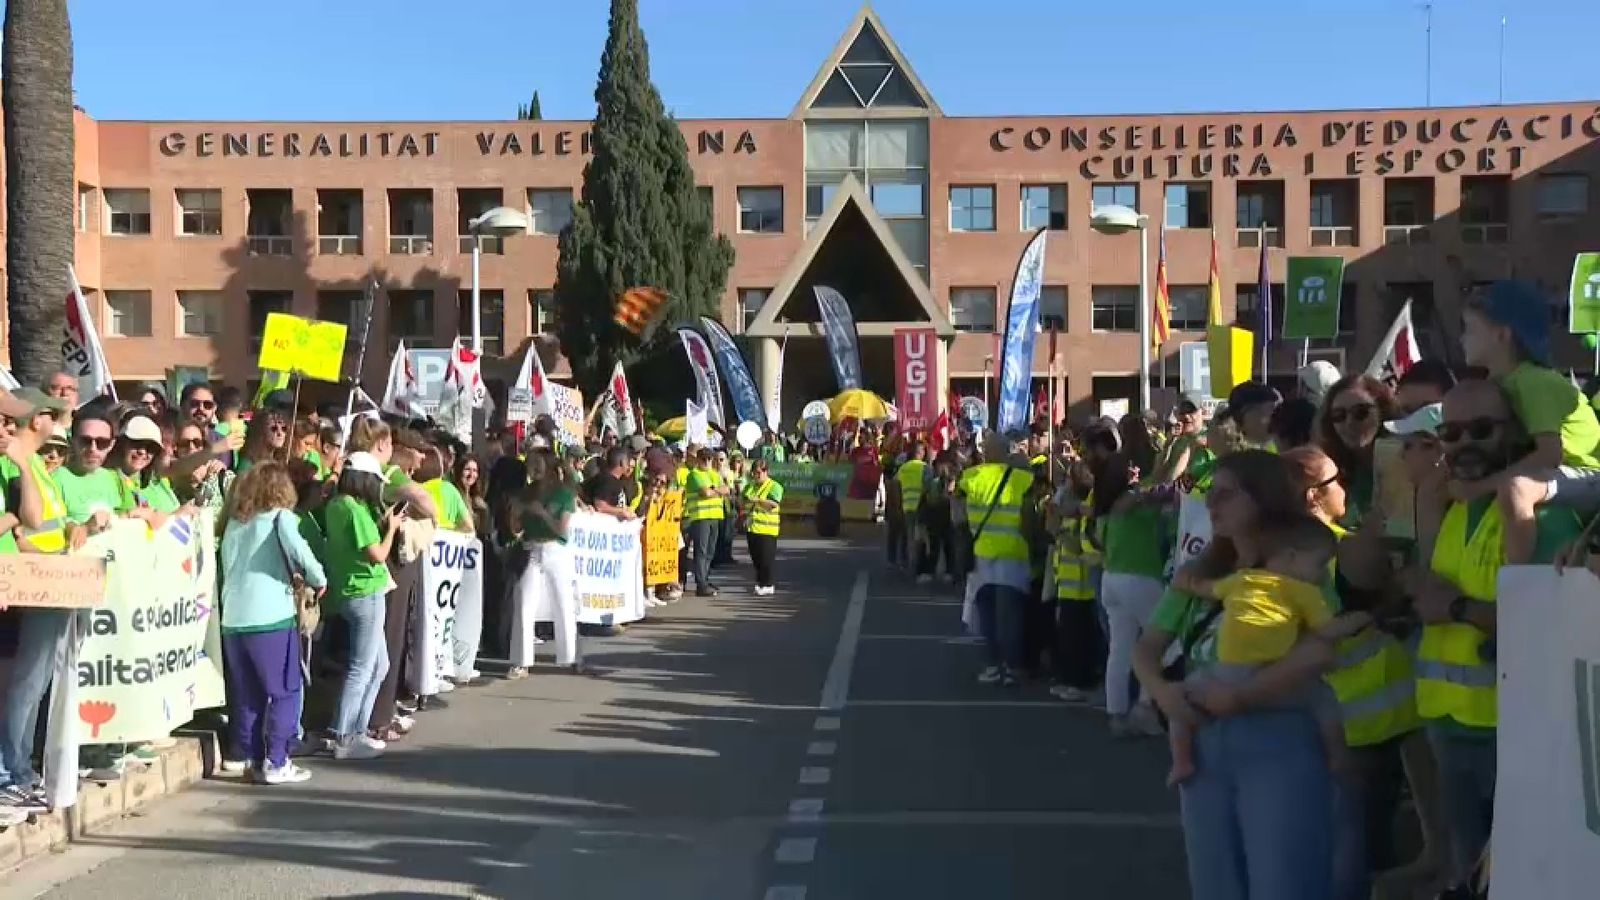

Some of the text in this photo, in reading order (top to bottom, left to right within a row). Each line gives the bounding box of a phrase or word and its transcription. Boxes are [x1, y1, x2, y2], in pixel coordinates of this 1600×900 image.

[159, 129, 757, 158] GENERALITAT VALENA
[989, 122, 1298, 152] CONSELLERIA
[1079, 146, 1526, 180] CULTURA I ESPORT
[418, 356, 447, 396] P
[904, 332, 928, 413] UGT
